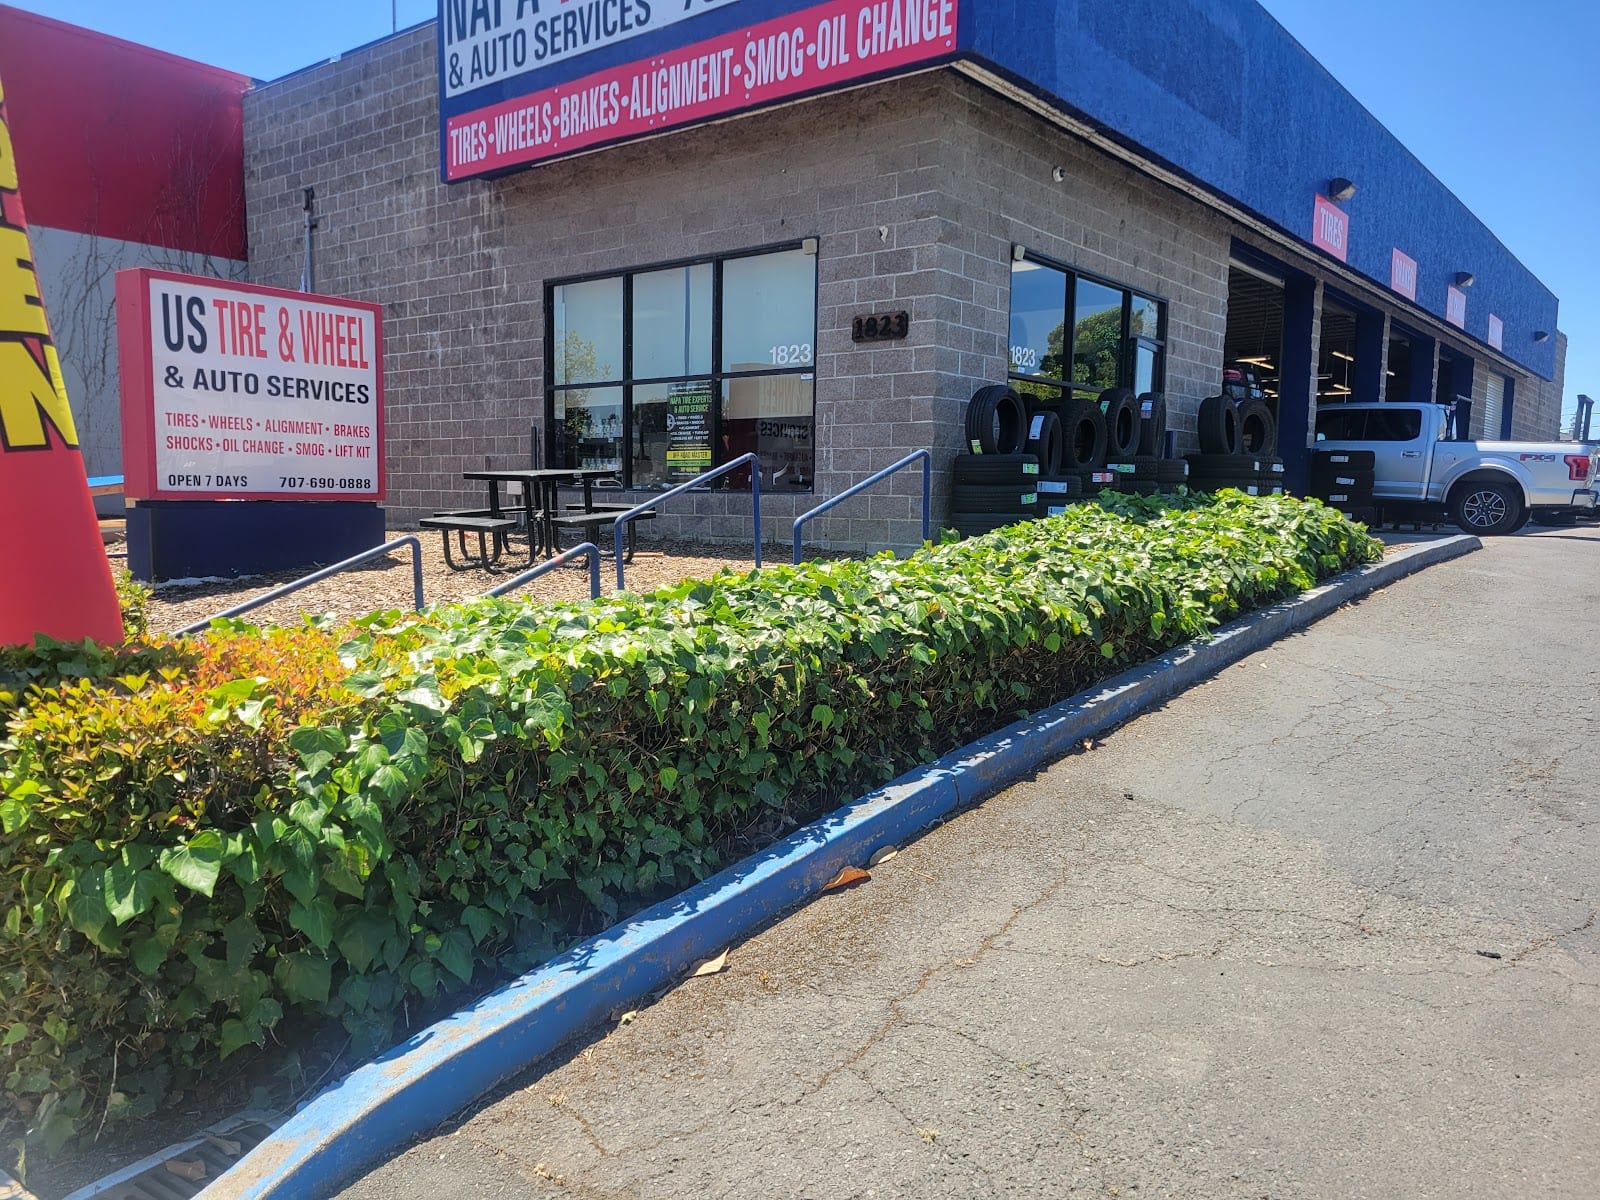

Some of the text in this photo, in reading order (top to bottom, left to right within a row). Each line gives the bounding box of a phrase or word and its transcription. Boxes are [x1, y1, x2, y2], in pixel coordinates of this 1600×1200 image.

[449, 0, 651, 90] & AUTO SERVICES
[451, 0, 953, 166] TIRES WHEELS BRAKES ALIGNMENT SMOG OIL CHANGE
[1320, 207, 1343, 249] TIRES
[162, 293, 369, 370] US TIRE & WHEEL
[854, 314, 906, 339] 1823
[769, 343, 812, 365] 1823
[1010, 345, 1036, 367] 1823
[164, 365, 370, 405] & AUTO SERVICES
[165, 412, 370, 438] TIRES WHEELS ALIGNMENT BRAKES
[166, 435, 371, 458] SHOCKS OIL CHANGE SMOG LIFT KIT
[1520, 453, 1555, 463] FX4
[168, 474, 371, 489] OPEN 7 DAYS 707-690-0888
